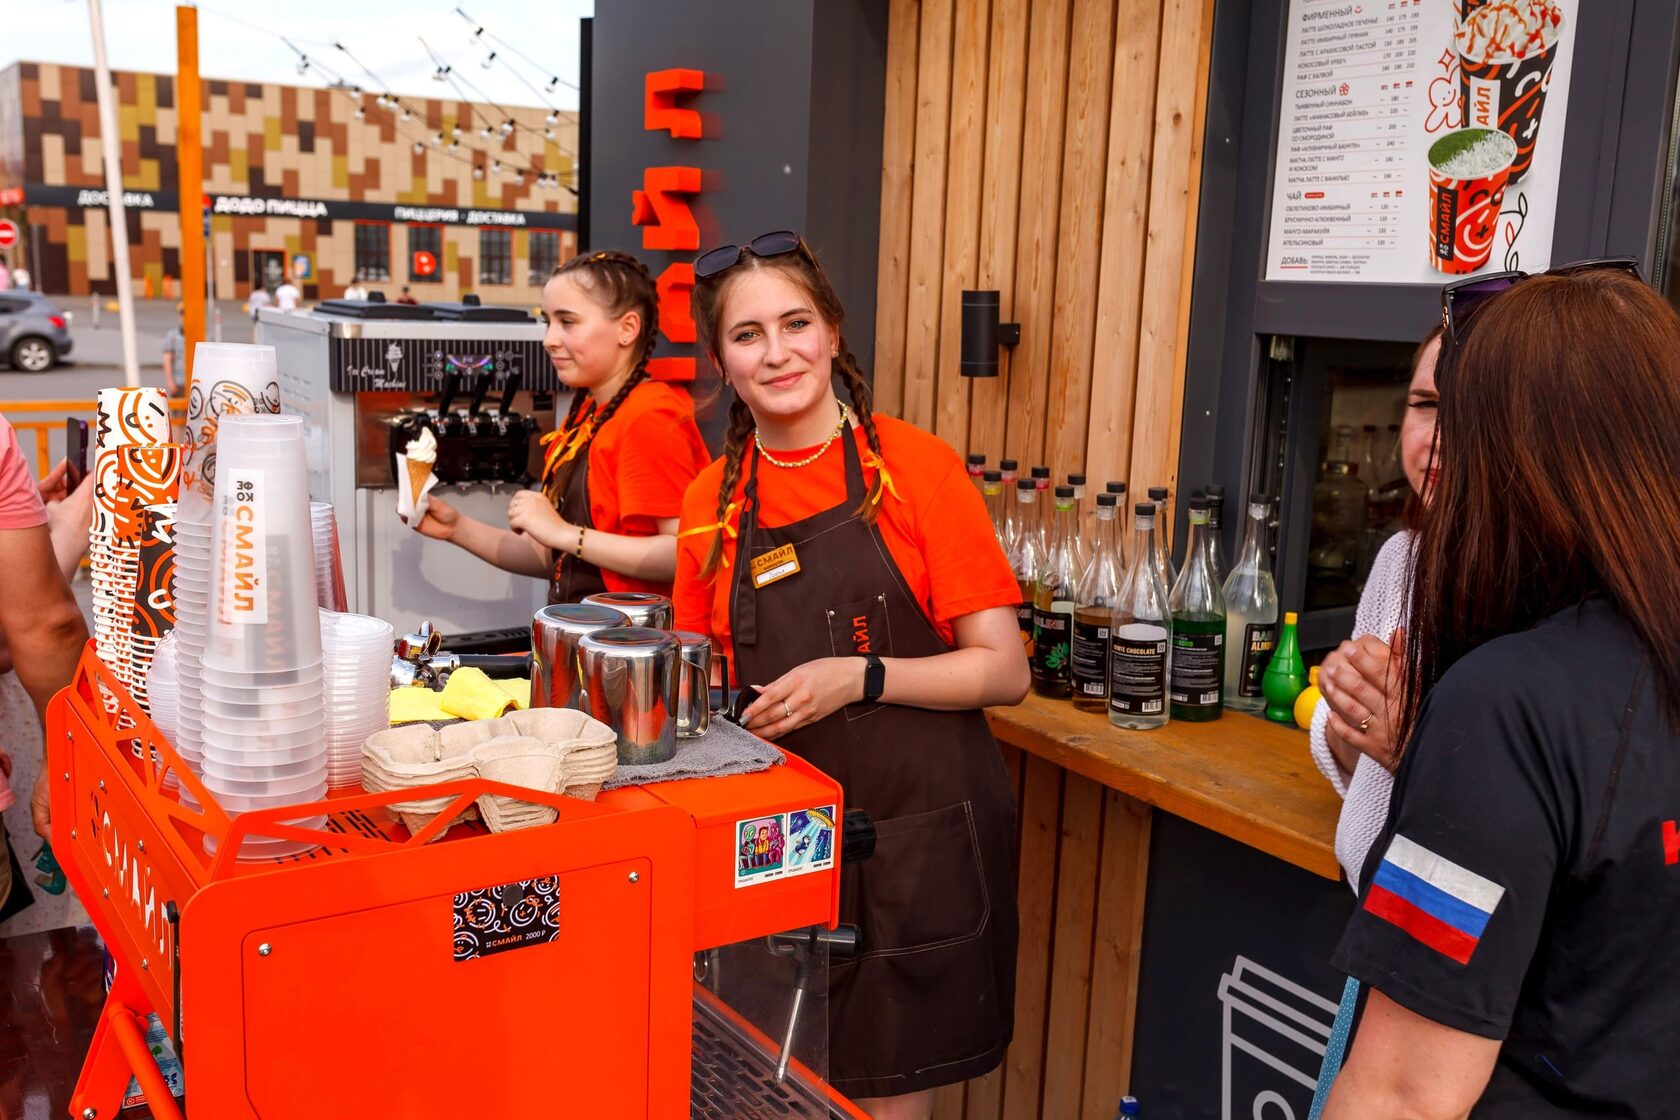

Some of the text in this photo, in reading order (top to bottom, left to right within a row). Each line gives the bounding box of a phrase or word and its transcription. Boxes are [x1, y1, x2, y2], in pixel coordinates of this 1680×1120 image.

[1302, 5, 1352, 21] ФИРМЕННЫЙ
[1295, 85, 1337, 99] СЕЗОННЫЙ
[1476, 86, 1491, 127] АЙЛ
[77, 189, 154, 208] ДОСВКА
[1286, 191, 1302, 200] ЧАЙ
[214, 196, 328, 217] ДОДО ПИЦЦА
[394, 206, 526, 225] ПИЦЦЕРИЯ ДОСТАВКА
[1440, 192, 1452, 244] СМАЙЛ
[234, 505, 259, 611] СМАЙЛ
[756, 546, 793, 567] СМАЙЛ
[852, 615, 871, 653] АЙЛ
[1126, 647, 1156, 655] CHOCOLATE
[102, 809, 172, 969] СМАЙЛ
[491, 934, 523, 947] СМАЙЛ
[525, 931, 541, 940] 2000
